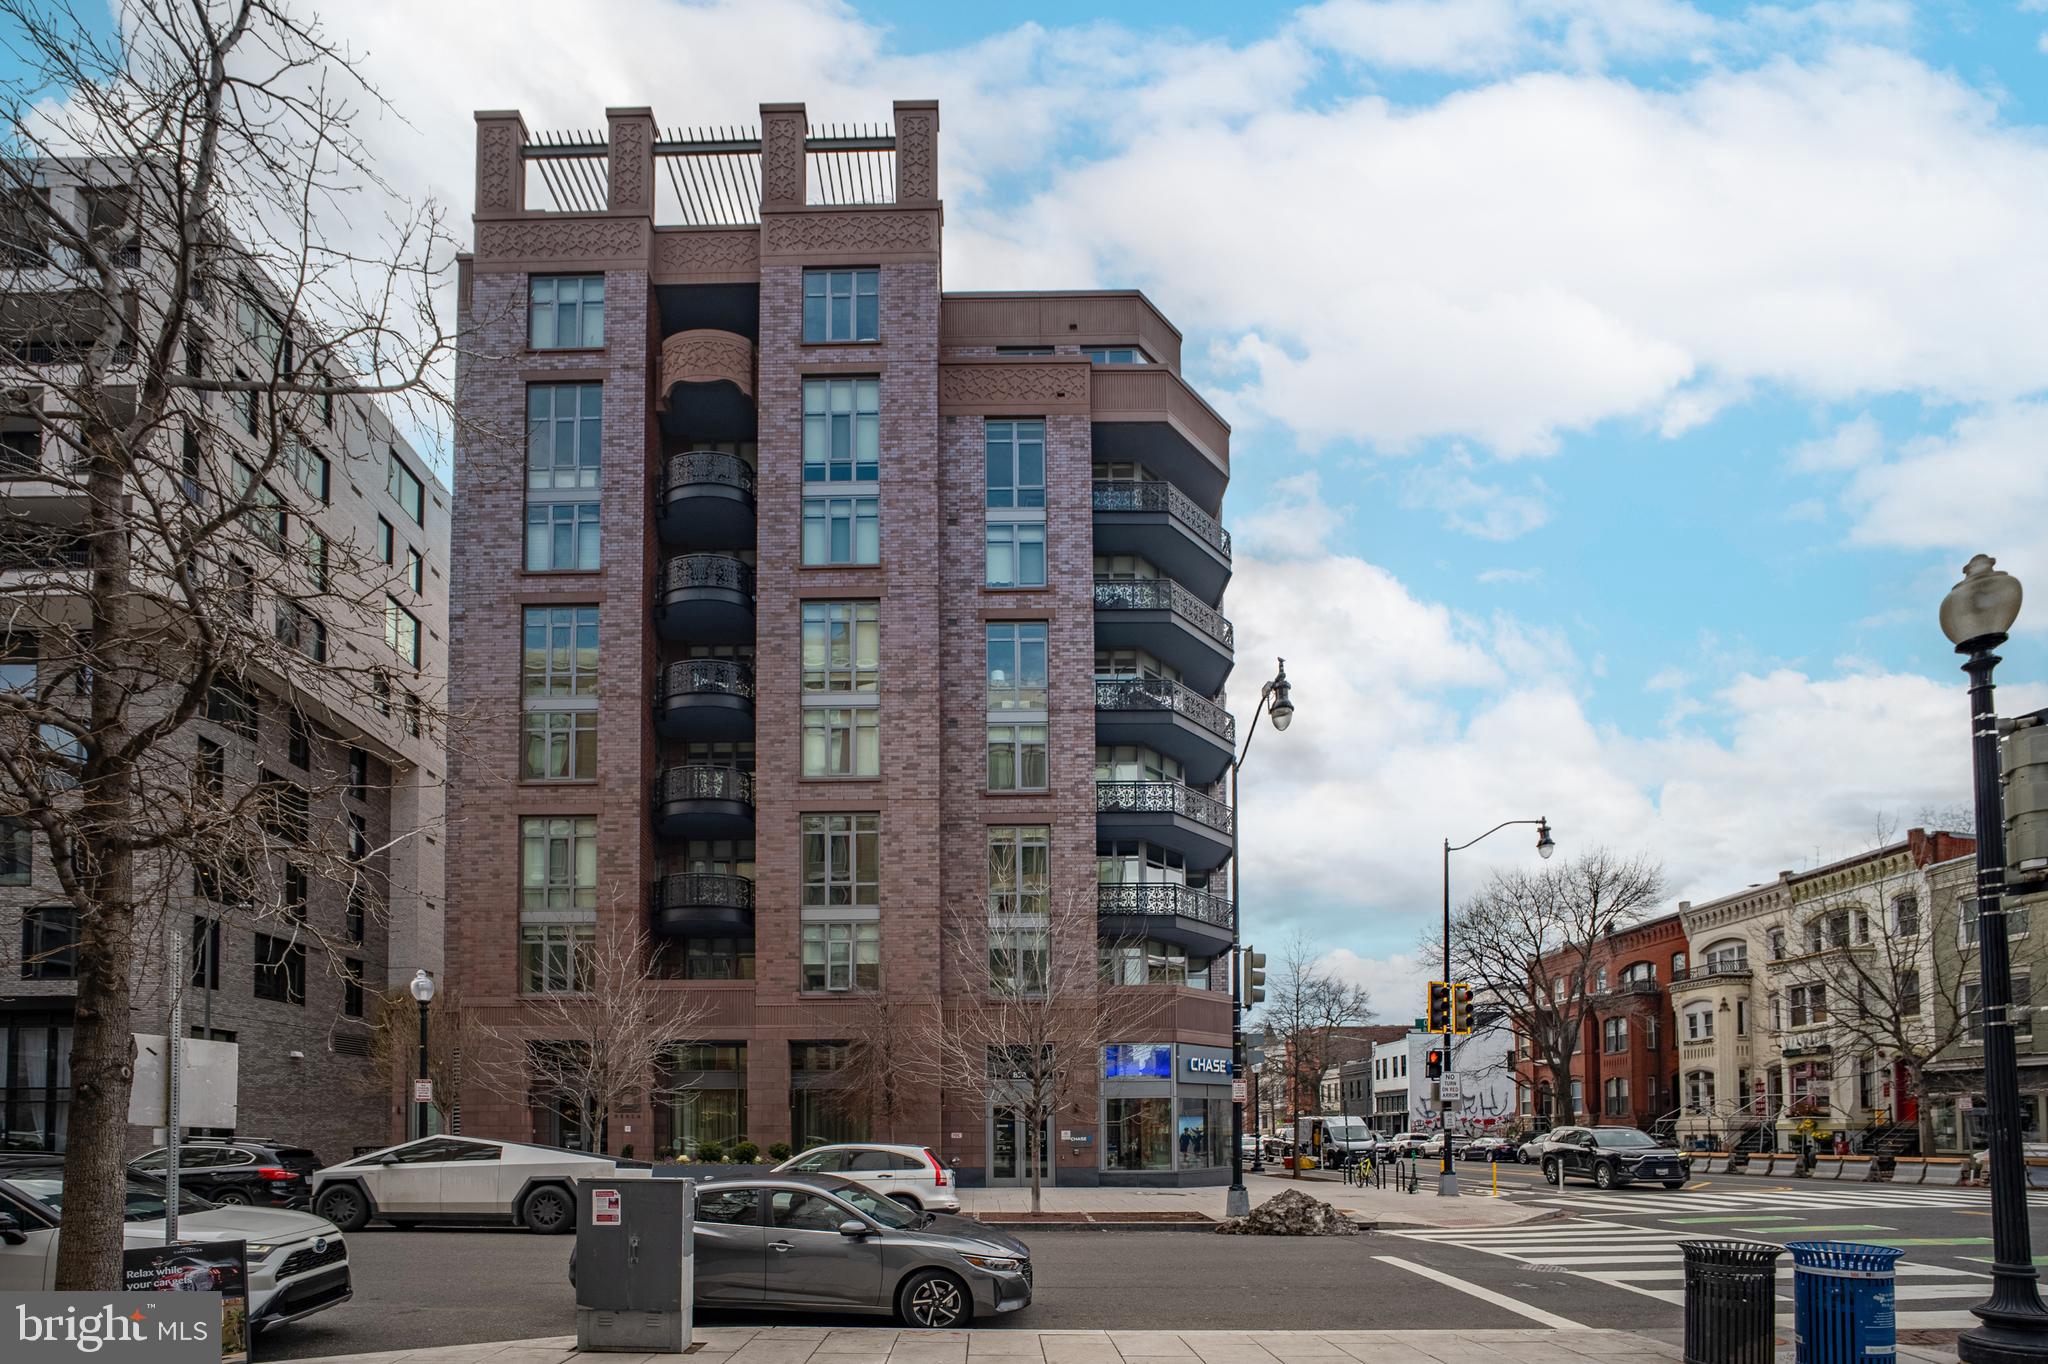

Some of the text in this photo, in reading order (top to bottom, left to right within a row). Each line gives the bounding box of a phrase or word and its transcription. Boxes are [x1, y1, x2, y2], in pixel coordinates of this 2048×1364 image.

[1190, 1057, 1226, 1073] CHASE
[126, 1265, 183, 1279] Relax while
[126, 1281, 151, 1291] your
[170, 1277, 193, 1287] gets
